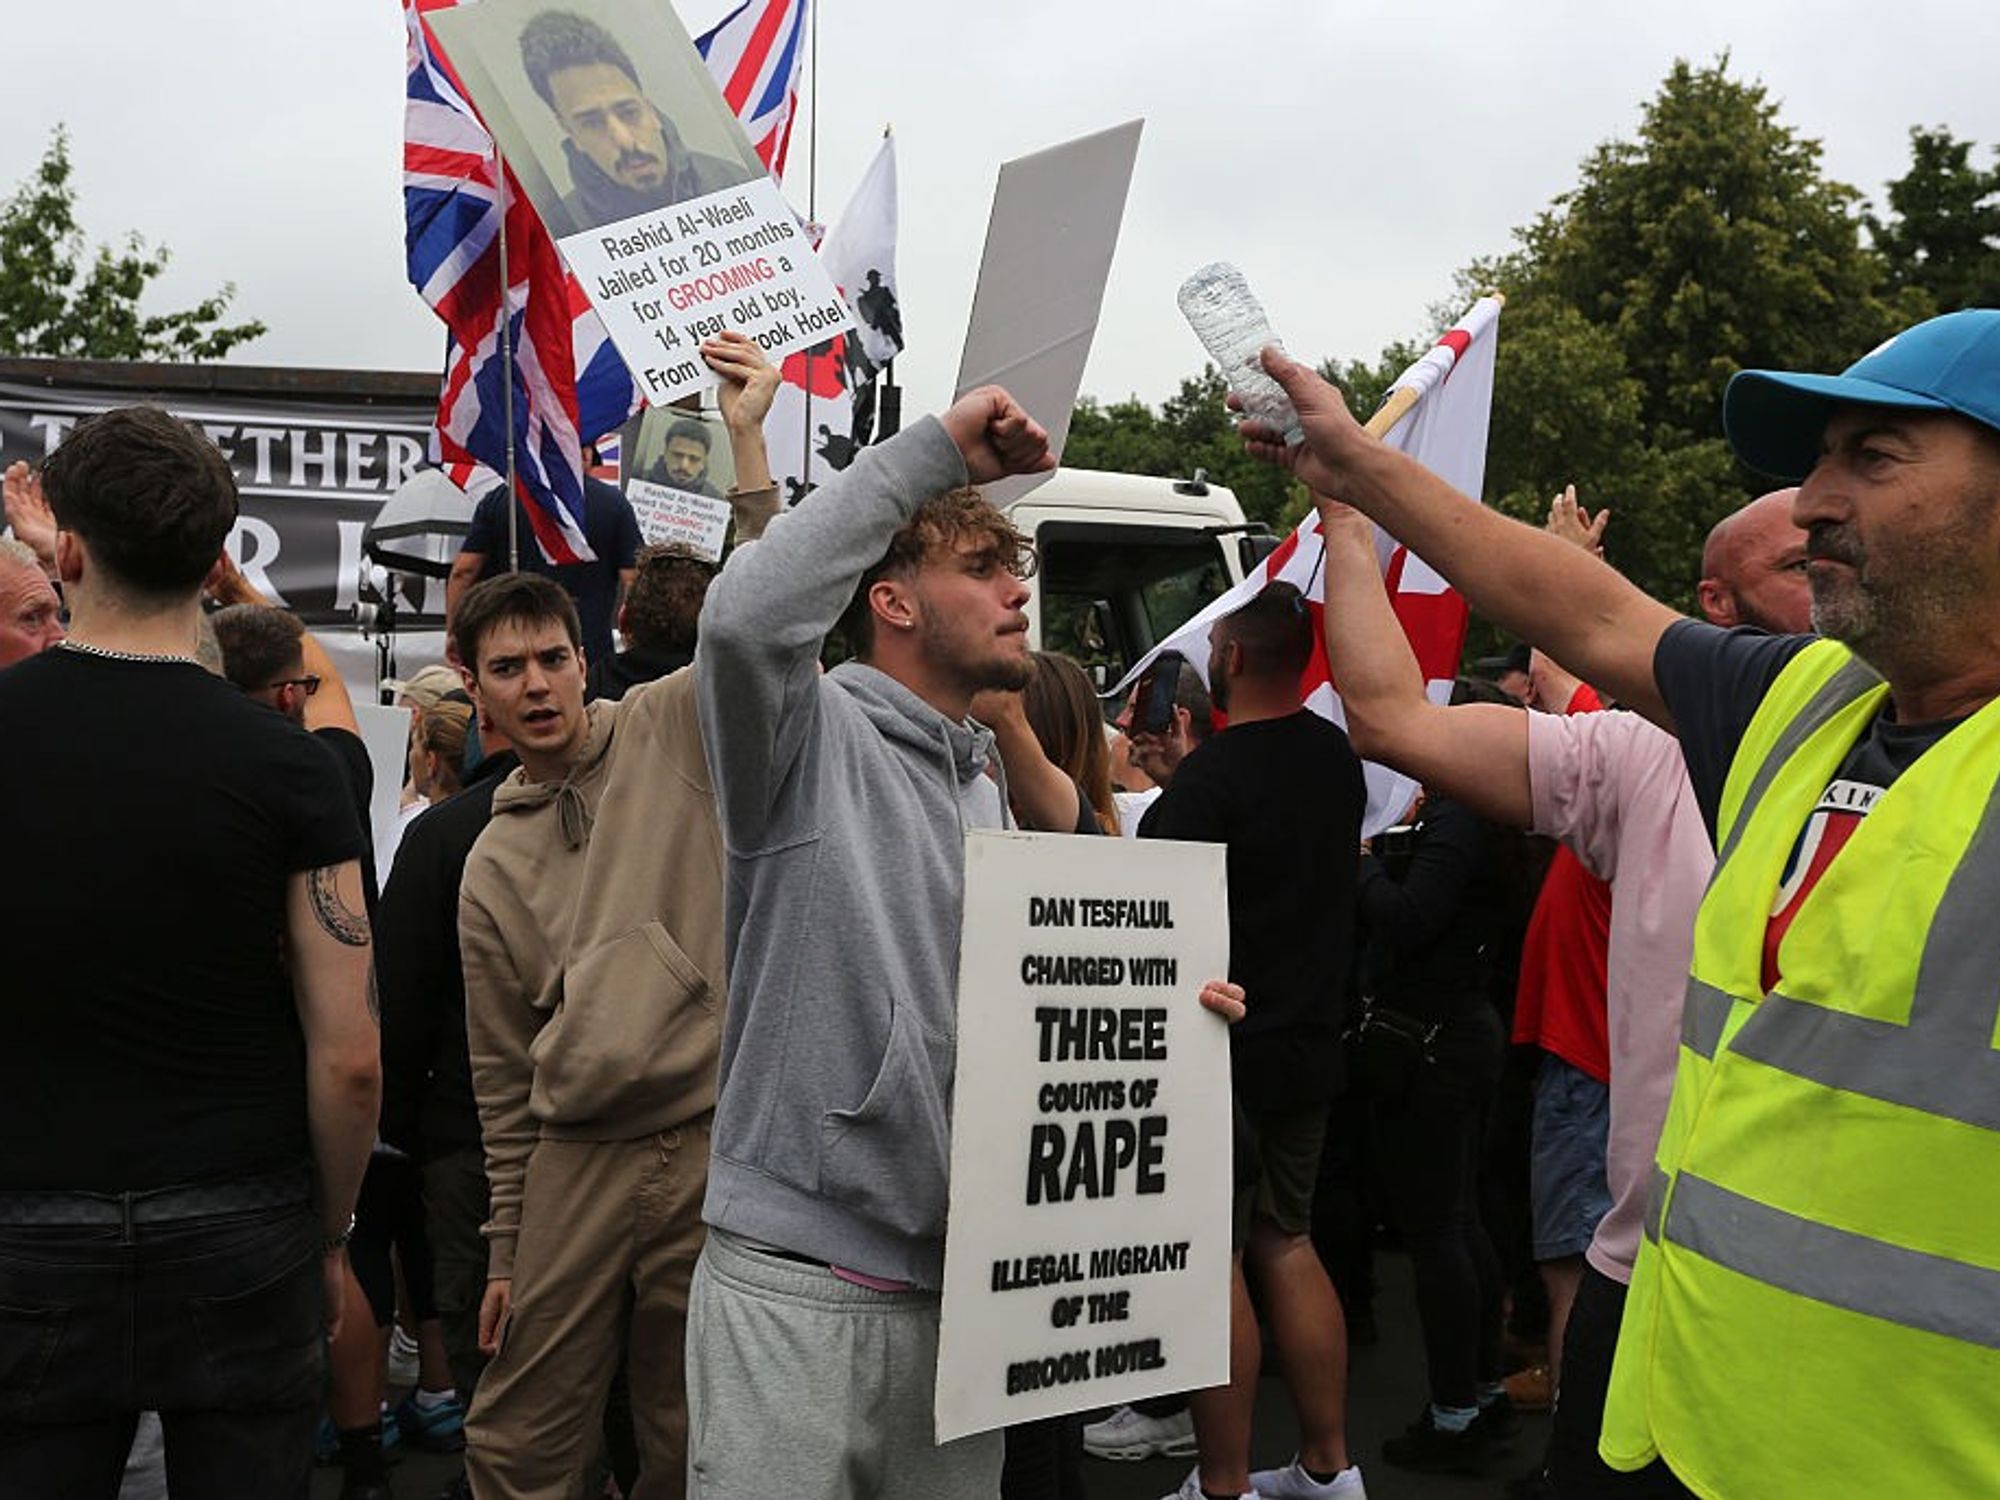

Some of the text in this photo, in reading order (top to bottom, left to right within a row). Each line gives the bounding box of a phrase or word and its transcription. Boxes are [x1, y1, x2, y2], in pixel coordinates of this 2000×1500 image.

[601, 196, 755, 261] Rashid Al-Waeli
[598, 220, 795, 300] Jailed for 20 months
[632, 256, 793, 324] for GROOMING a
[644, 359, 700, 393] From
[751, 321, 795, 350] ook
[794, 299, 846, 336] Hotel
[655, 287, 806, 350] 14 year old boy.
[30, 414, 424, 490] TETHER
[1029, 896, 1174, 929] DAN TESFALUL
[1021, 954, 1178, 986] CHARGED WITH
[1034, 1006, 1168, 1062] THREE
[1038, 1078, 1159, 1113] COUNTS OF
[1026, 1115, 1168, 1206] RAPE
[991, 1241, 1190, 1293] ILLEGAL MIGRANT
[1051, 1290, 1131, 1329] OF THE
[1007, 1337, 1167, 1397] BROOK HOTEL
